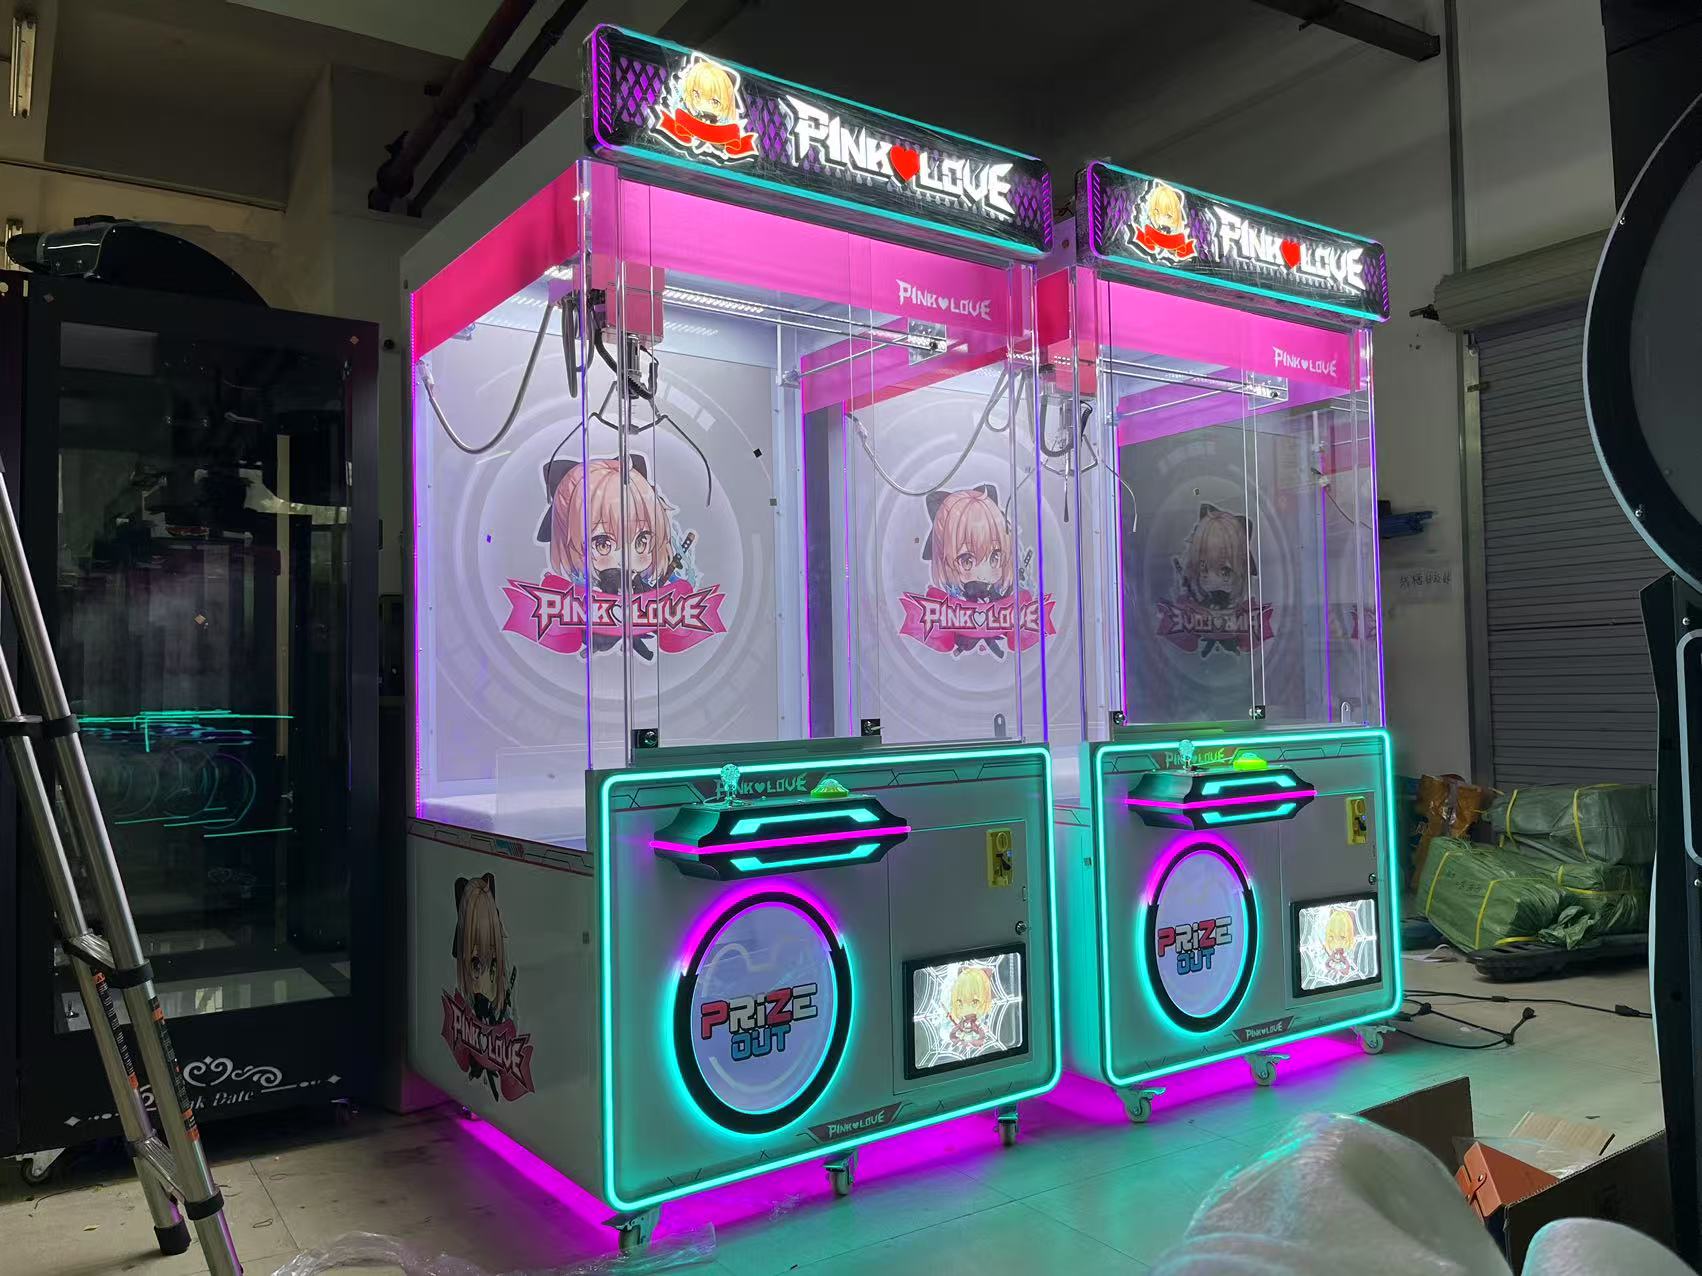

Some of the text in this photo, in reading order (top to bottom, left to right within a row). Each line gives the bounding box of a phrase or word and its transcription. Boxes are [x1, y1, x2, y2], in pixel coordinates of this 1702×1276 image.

[785, 94, 1015, 217] PINK LOVE
[1213, 206, 1366, 292] PINK LOVE
[896, 279, 992, 321] PINK LOVE
[1272, 345, 1337, 377] PINK LOVE
[527, 587, 711, 638] PINK LOVE
[917, 599, 976, 638] PINK
[766, 772, 808, 793] LOVE
[1177, 947, 1216, 976] OUT
[452, 1002, 526, 1082] PINK LOVE
[731, 1023, 791, 1062] OUT
[827, 1110, 885, 1139] PINK LOVE
